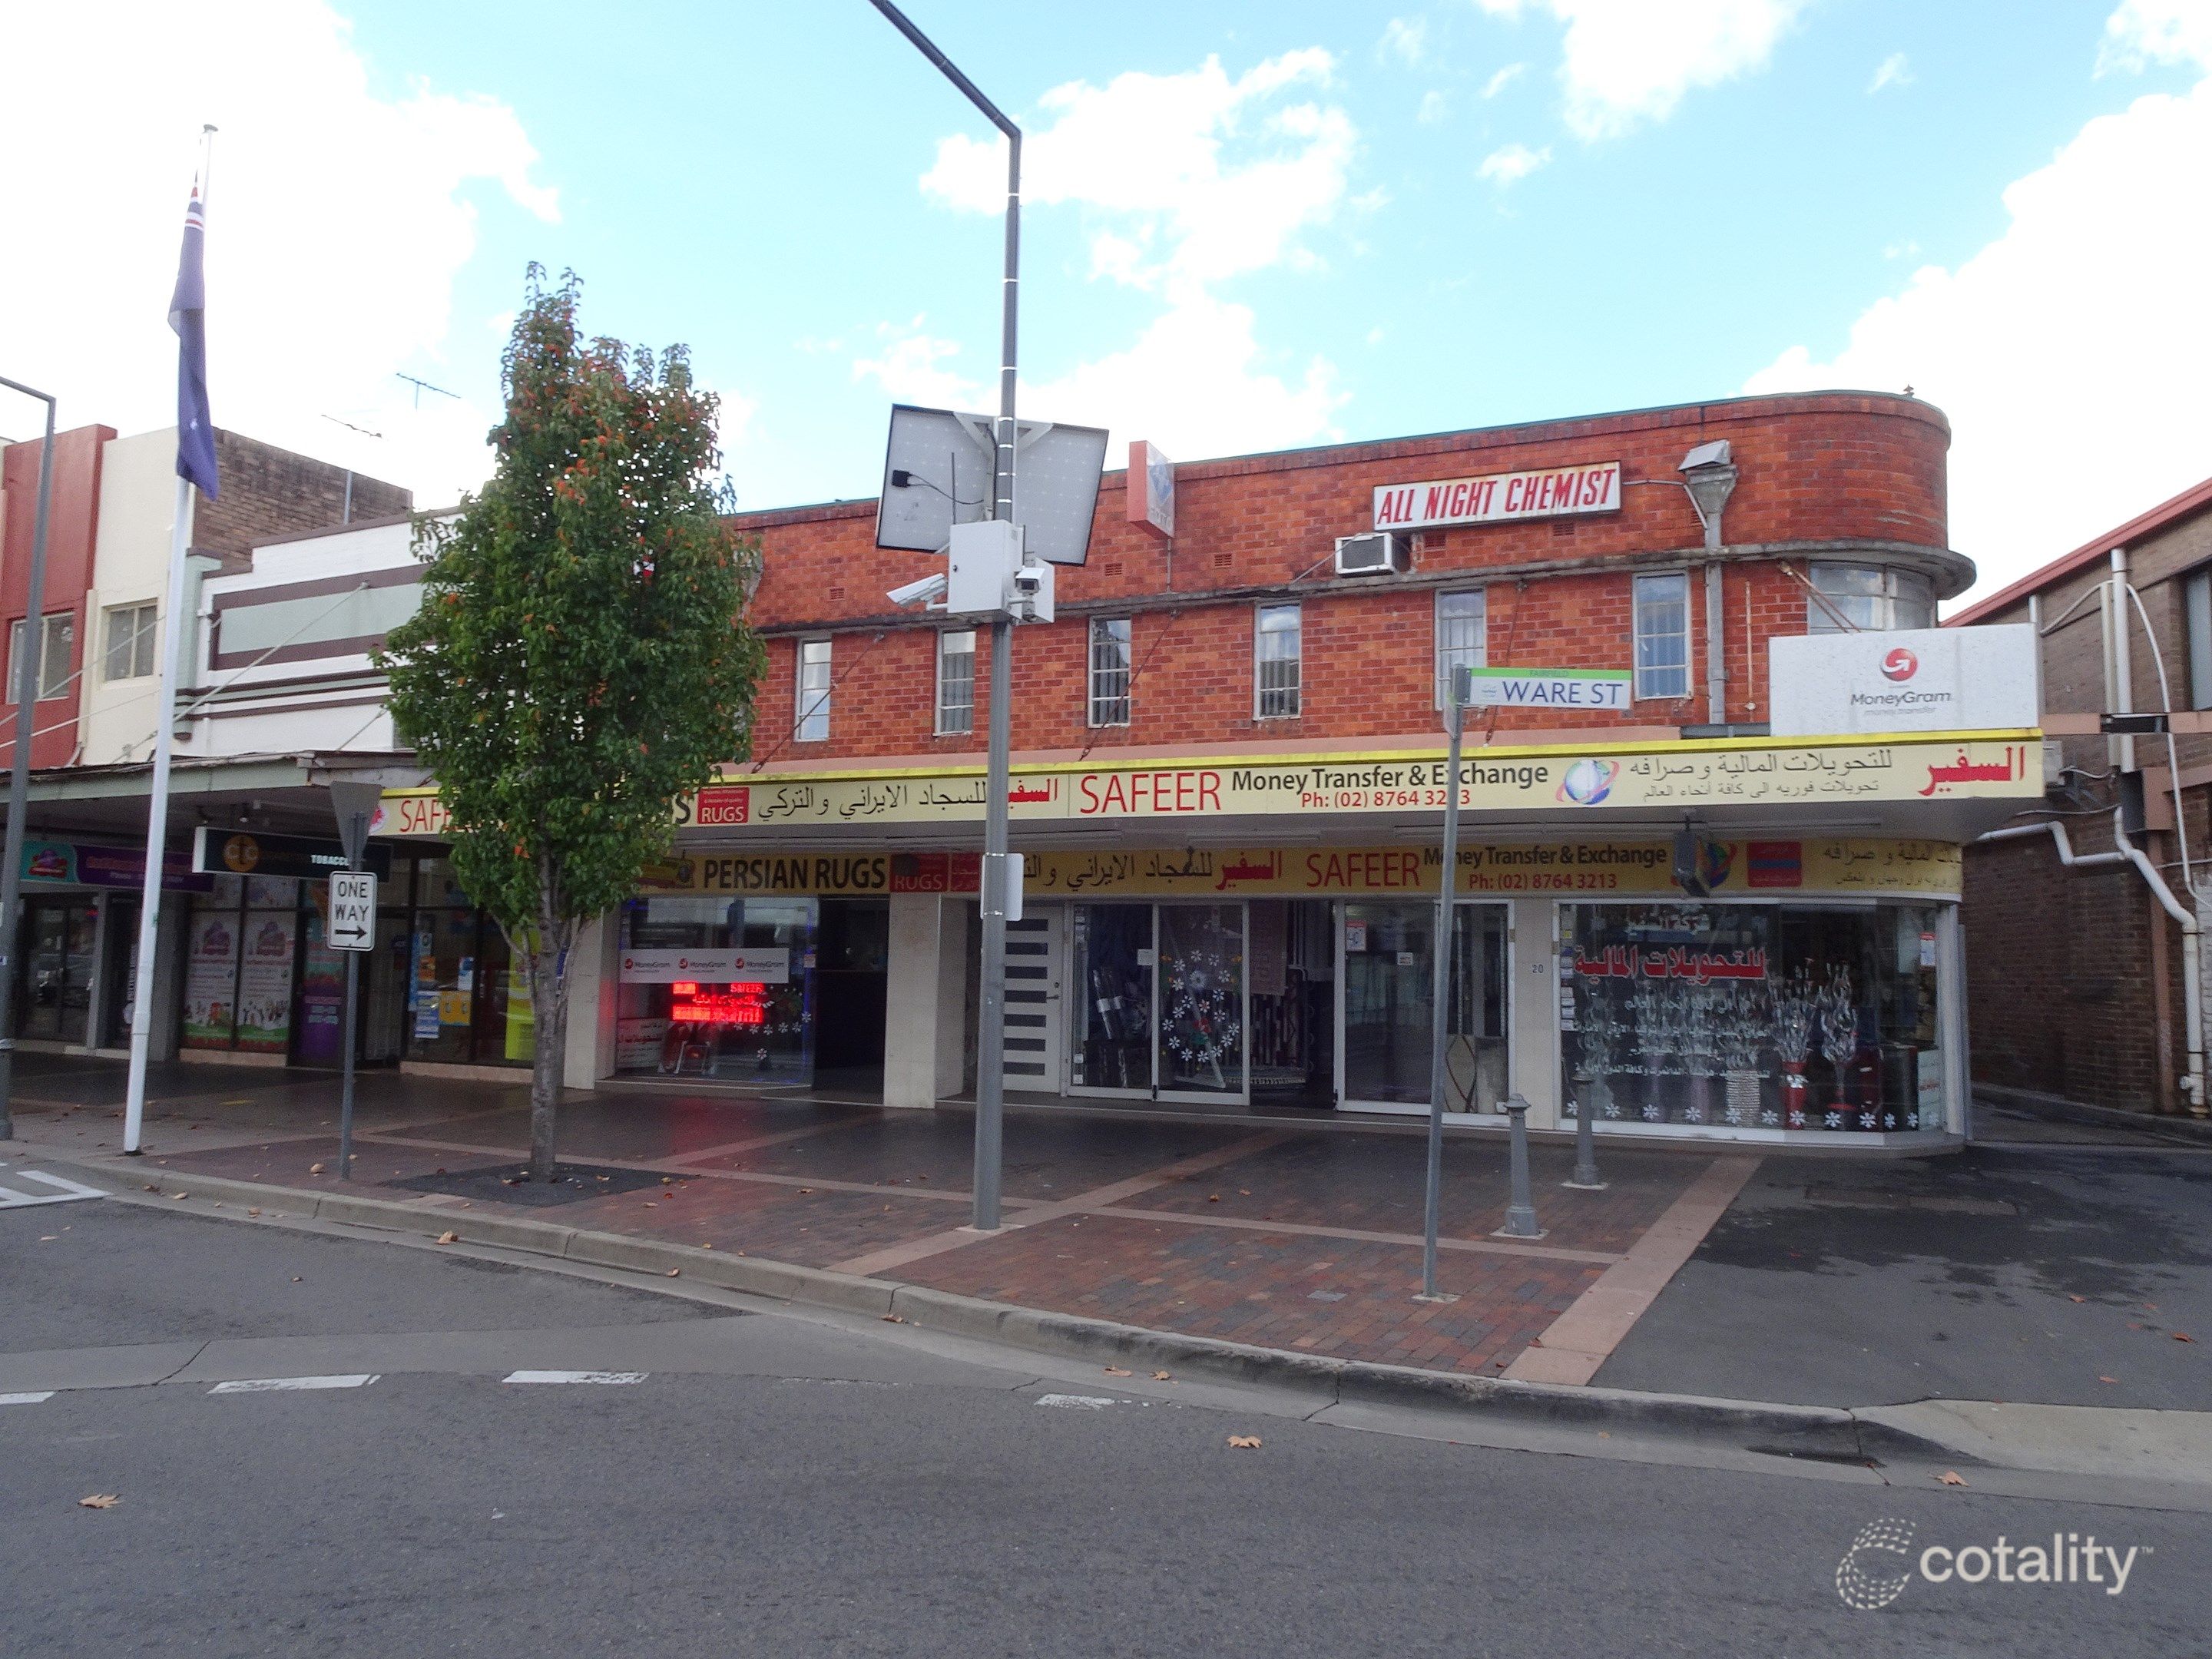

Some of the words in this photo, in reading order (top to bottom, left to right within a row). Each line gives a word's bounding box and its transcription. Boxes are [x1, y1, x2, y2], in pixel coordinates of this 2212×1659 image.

[1377, 489, 1415, 524] ALL
[1423, 480, 1496, 520] NIGHT
[1505, 469, 1615, 512] CHEMIST
[1502, 680, 1581, 704] WARE
[1590, 683, 1623, 704] ST
[1850, 691, 1951, 707] MoneyGram
[1717, 753, 1777, 779] المالية
[1783, 749, 1892, 777] للتحويلات
[1918, 745, 2025, 796] السفير
[1008, 778, 1058, 809] السفي
[1079, 771, 1222, 814] SAFEER
[1232, 770, 1309, 795] Money
[1312, 766, 1401, 790] Transfer
[1409, 766, 1427, 786] &
[1432, 763, 1548, 790] Echange
[758, 786, 813, 821] التركي
[919, 780, 986, 810] للسجاد
[1301, 791, 1330, 808] Ph:
[1334, 791, 1369, 808] (02)
[1374, 790, 1419, 806] 8764
[1424, 790, 1470, 806] 323
[700, 806, 743, 823] RUGS
[1215, 850, 1283, 890] السفير
[1306, 852, 1421, 887] SAFEER
[1423, 848, 1482, 869] Mney
[1485, 846, 1556, 866] Transfer
[1560, 846, 1574, 864] &
[1578, 846, 1667, 869] Exchange
[704, 859, 807, 889] PERSIAN
[815, 857, 886, 889] RUGS
[895, 873, 943, 890] RUGS
[1469, 873, 1494, 889] Ph:
[1498, 873, 1528, 890] (02)
[1532, 873, 1573, 889] 8764
[1577, 873, 1617, 889] 3213
[337, 881, 368, 899] ONE
[334, 904, 369, 922] WAY
[747, 961, 784, 969] MoneyGram
[1573, 944, 1639, 985] المالية
[1642, 945, 1767, 985] للتحويلات
